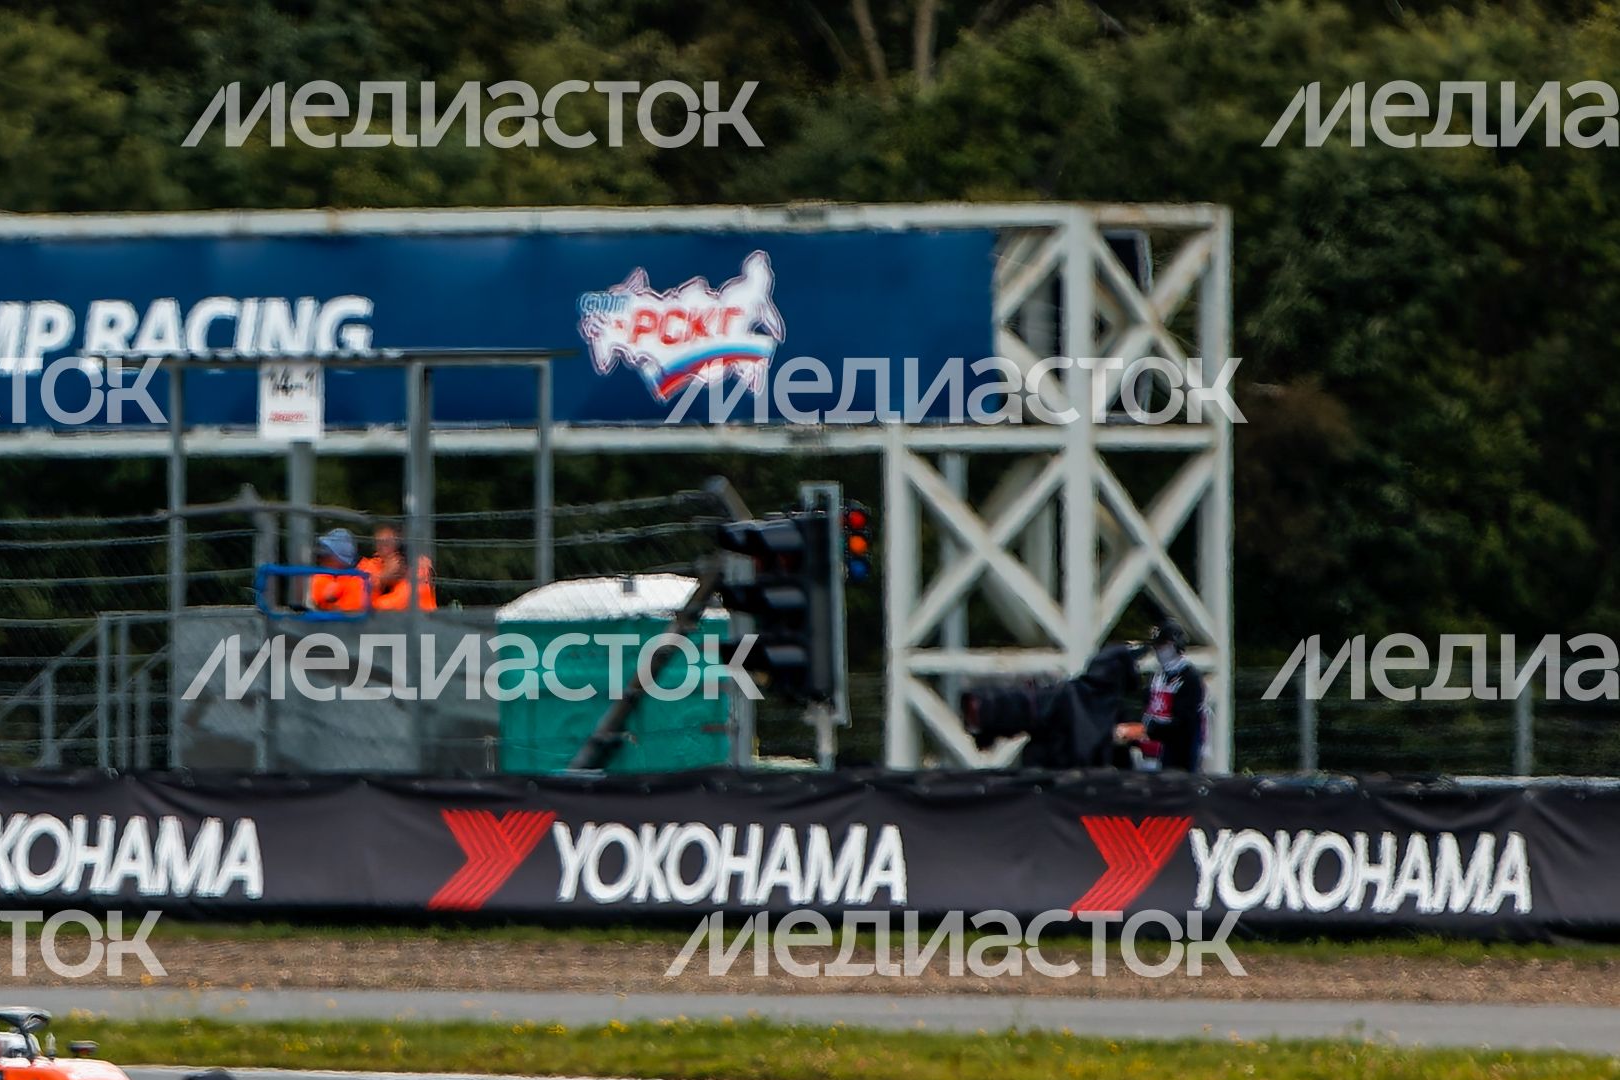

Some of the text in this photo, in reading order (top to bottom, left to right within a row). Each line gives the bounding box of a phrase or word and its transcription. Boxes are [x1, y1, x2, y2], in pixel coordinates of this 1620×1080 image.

[82, 295, 375, 374] RACING
[552, 821, 908, 906] YOKOHAMA
[1188, 827, 1533, 915] YOKOHAMA
